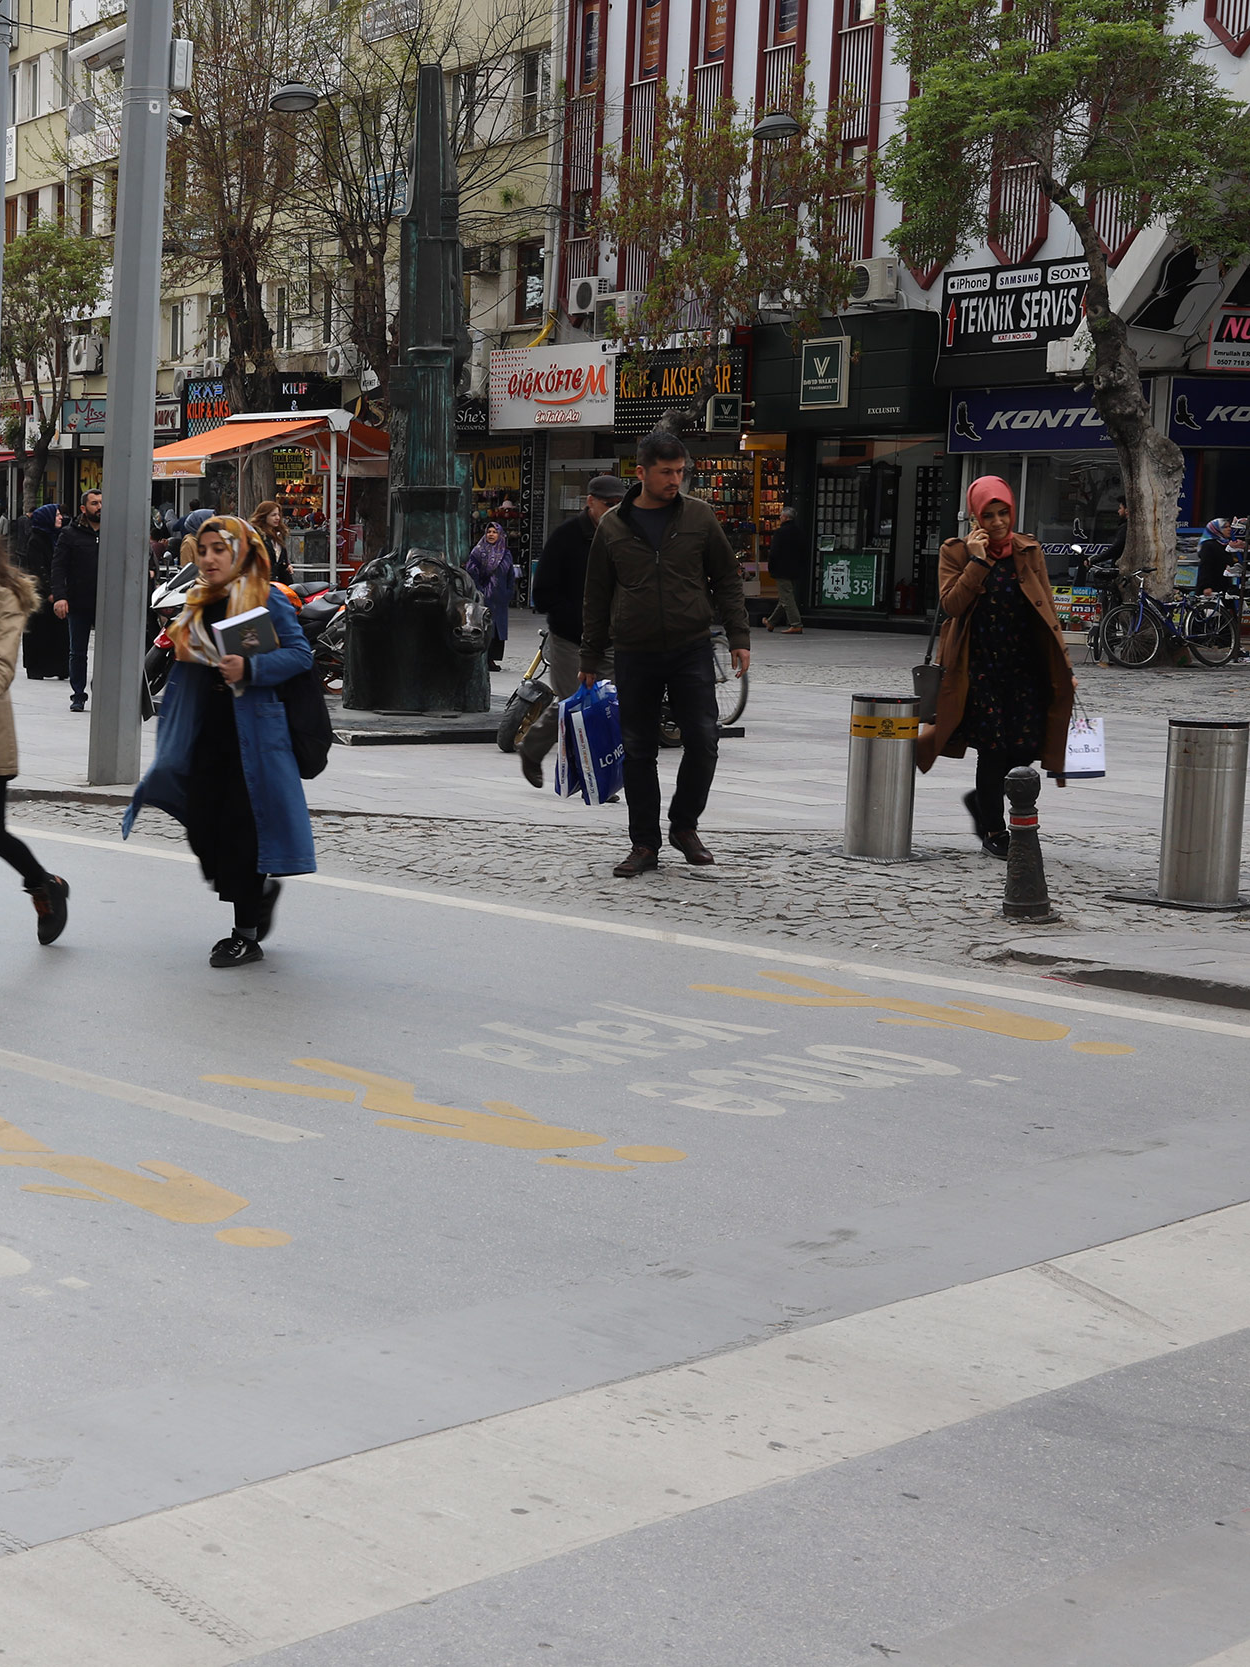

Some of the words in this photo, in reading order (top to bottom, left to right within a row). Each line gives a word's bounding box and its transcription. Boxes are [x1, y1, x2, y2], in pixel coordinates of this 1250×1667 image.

[999, 272, 1039, 286] SAMSUNG
[1050, 266, 1091, 281] SONY
[956, 276, 988, 290] iPhone
[661, 363, 731, 397] AKSESAR
[818, 377, 838, 385] WALKER
[281, 382, 309, 395] KILIF
[186, 402, 205, 419] KILIF
[206, 401, 213, 418] &
[213, 400, 231, 417] AKS
[455, 407, 487, 423] She's
[867, 406, 901, 415] EXCLUSIVE
[985, 407, 1105, 431] KONTU
[830, 575, 844, 585] 1+1
[599, 754, 614, 768] LC
